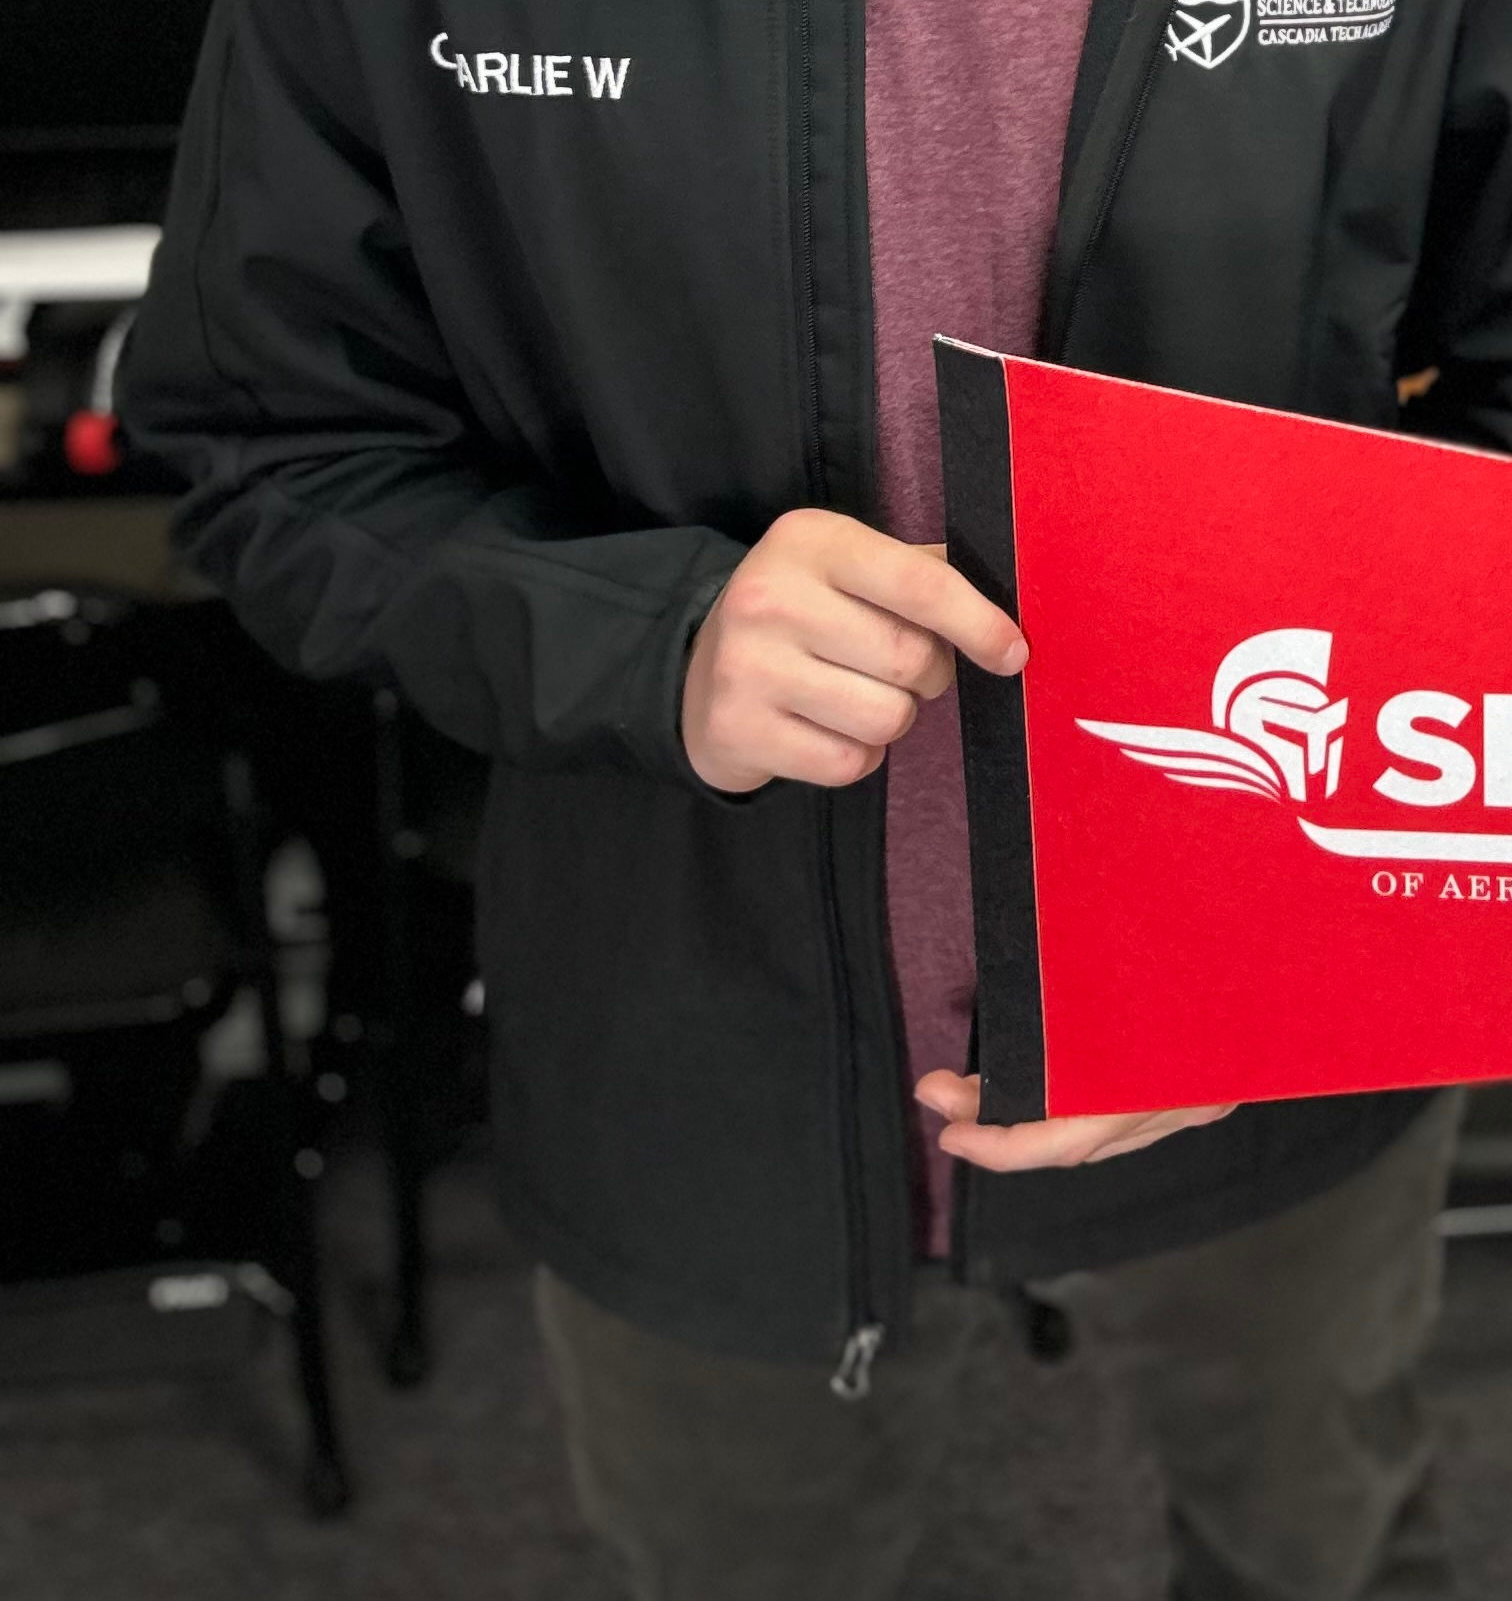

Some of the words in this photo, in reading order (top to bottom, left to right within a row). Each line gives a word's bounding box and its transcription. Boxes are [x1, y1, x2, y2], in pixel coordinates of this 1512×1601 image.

[1258, 26, 1330, 46] CASCADIA
[582, 55, 632, 100] W
[1371, 871, 1424, 897] OF
